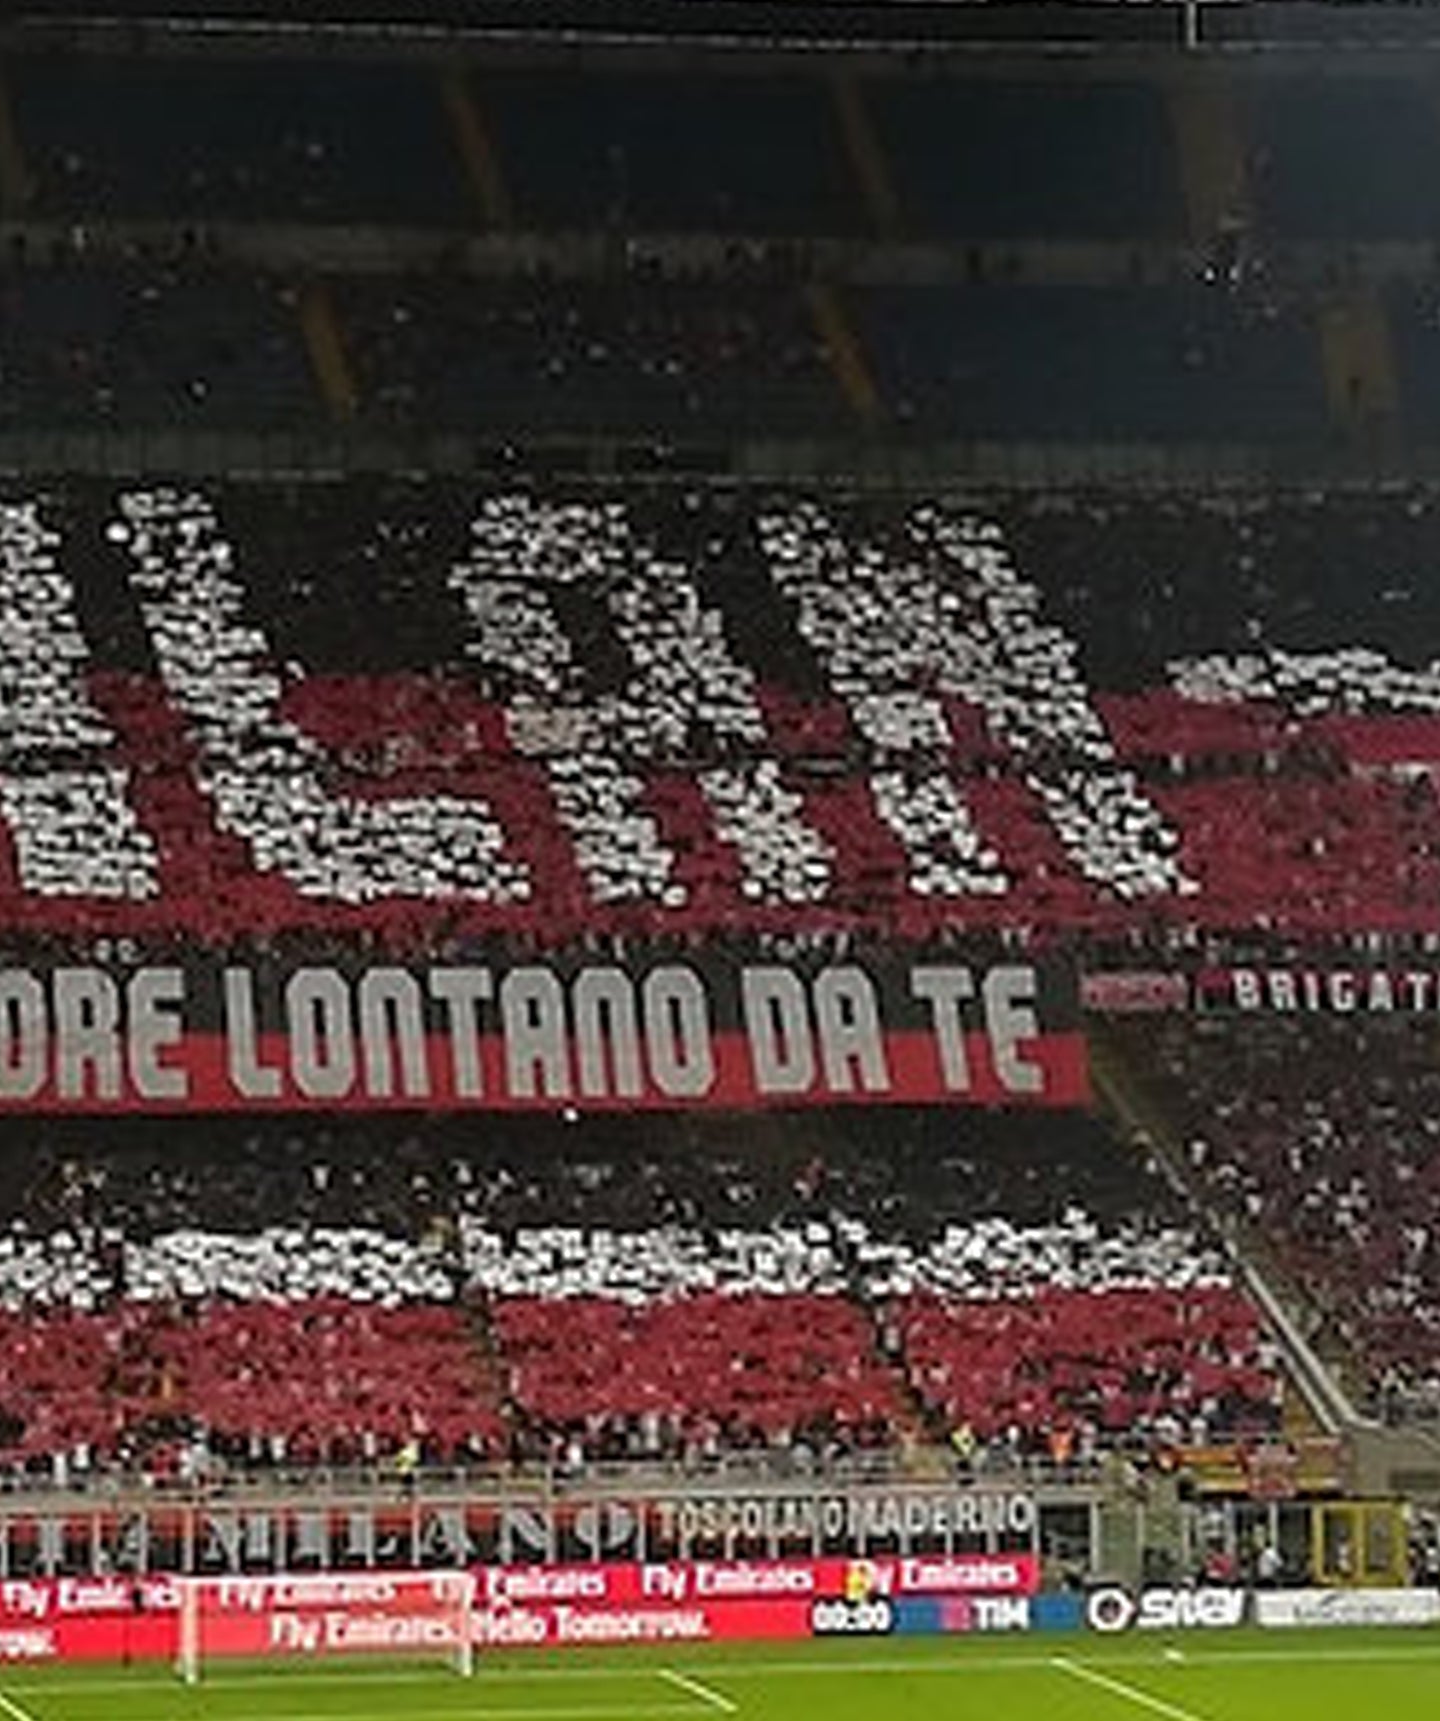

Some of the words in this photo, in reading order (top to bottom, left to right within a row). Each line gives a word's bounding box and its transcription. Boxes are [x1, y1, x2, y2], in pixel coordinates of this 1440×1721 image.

[224, 966, 717, 1099] LONTANO
[741, 966, 891, 1093] DA
[911, 966, 1045, 1093] TE
[3, 1581, 50, 1616] Fly
[643, 1564, 687, 1599] Fly
[975, 1599, 1030, 1630] TIM
